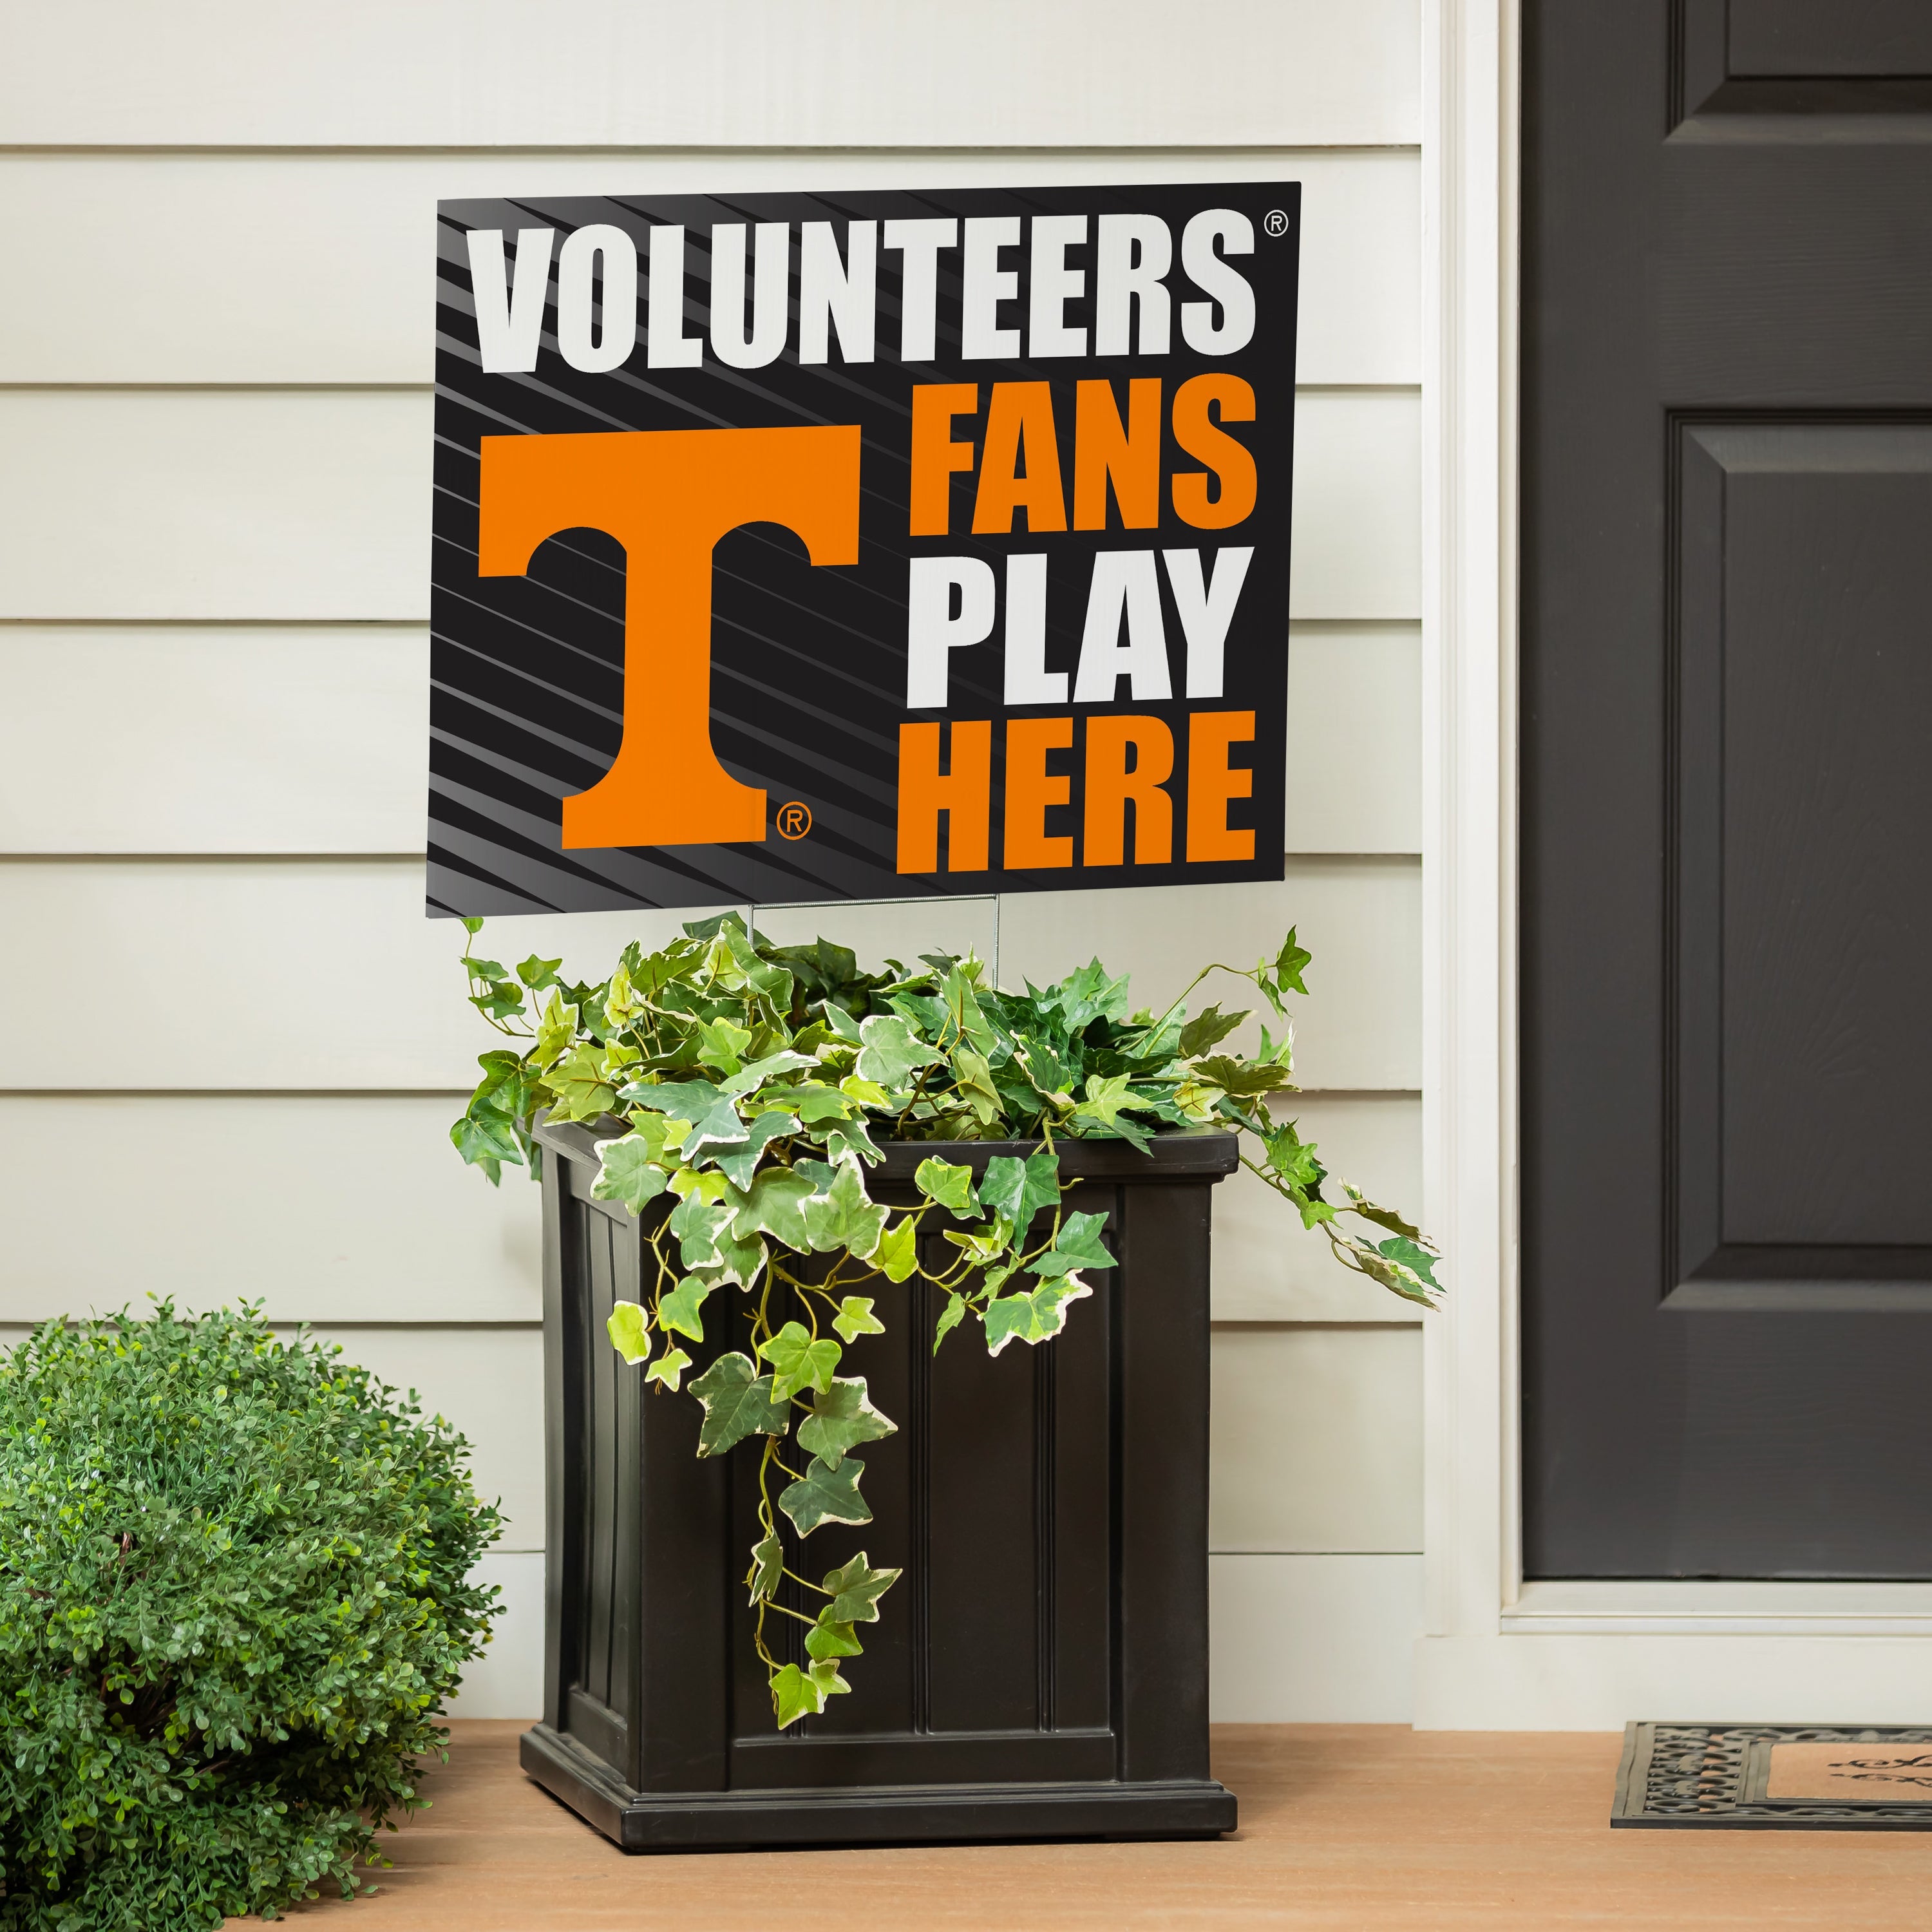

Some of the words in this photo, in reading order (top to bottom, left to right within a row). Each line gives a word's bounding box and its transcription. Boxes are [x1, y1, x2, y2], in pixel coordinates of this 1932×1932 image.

[910, 374, 1257, 536] FANS
[907, 547, 1255, 709] PLAY
[897, 711, 1255, 875] HERE
